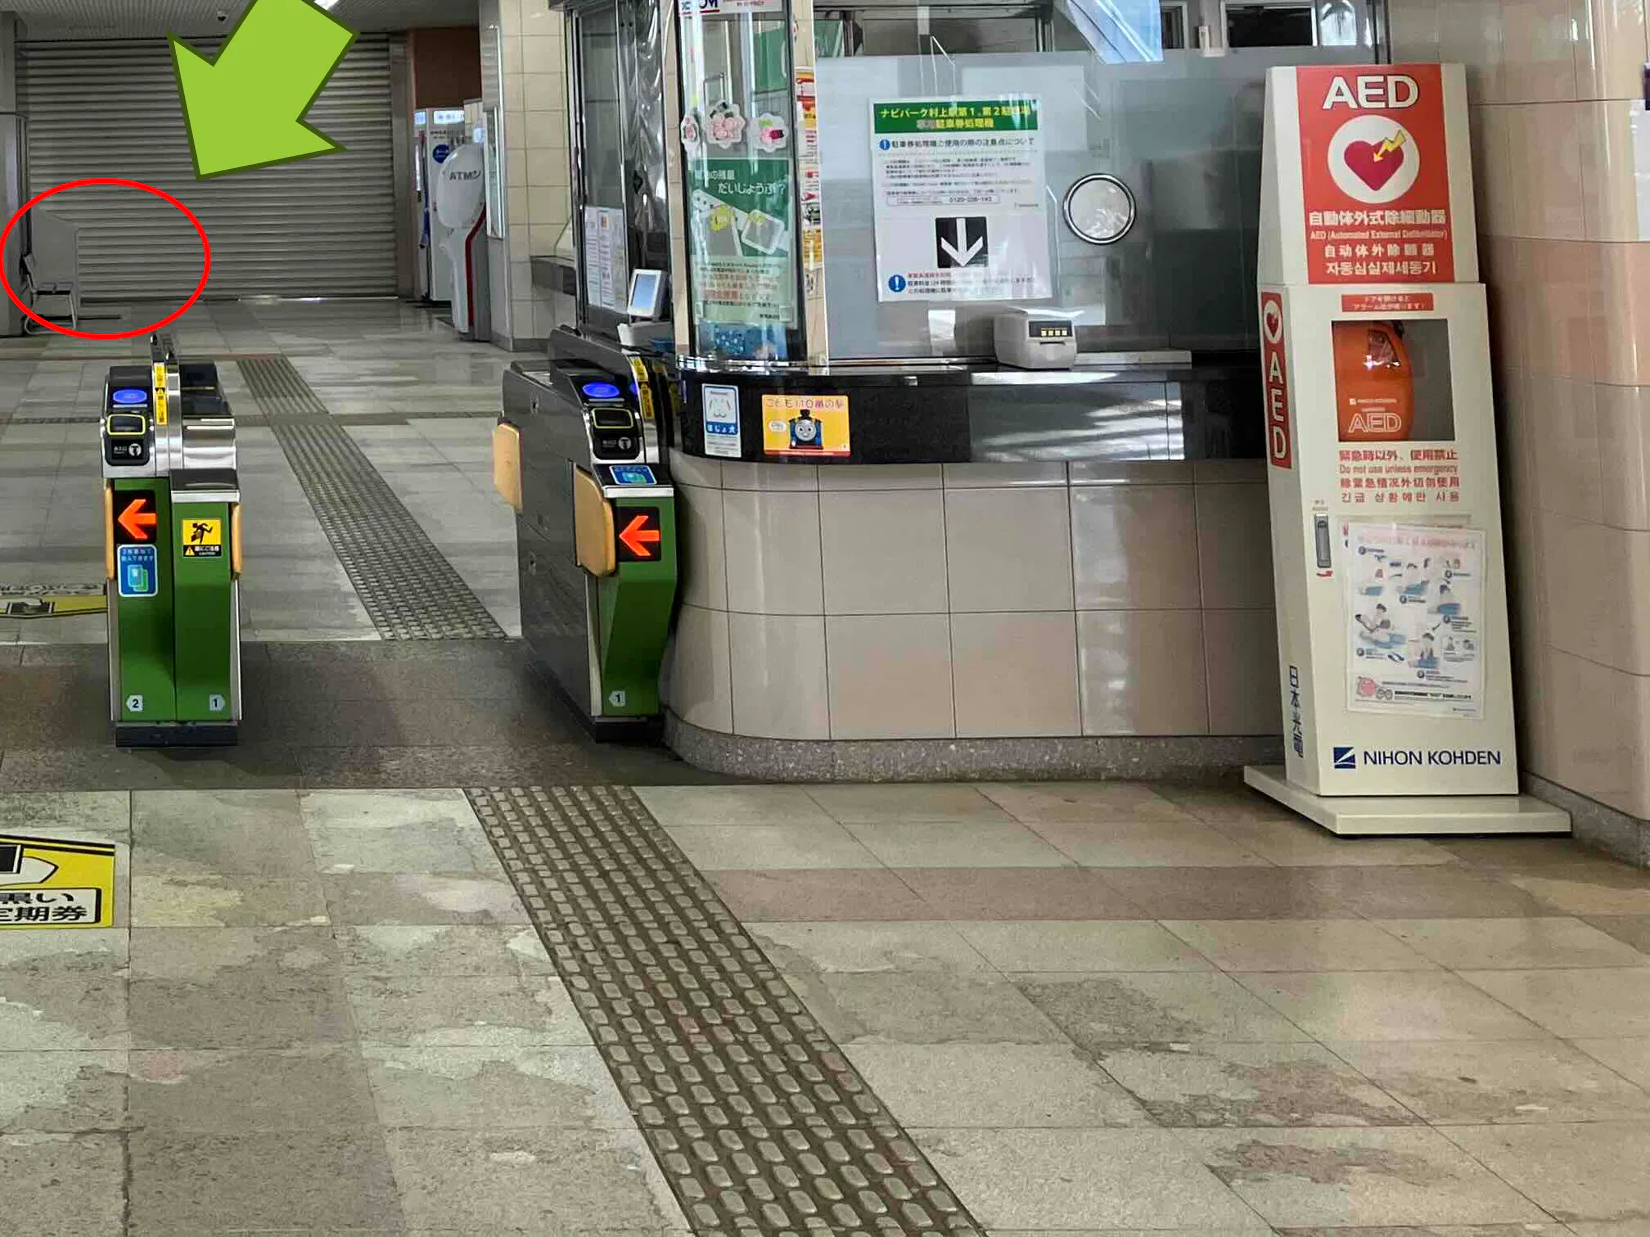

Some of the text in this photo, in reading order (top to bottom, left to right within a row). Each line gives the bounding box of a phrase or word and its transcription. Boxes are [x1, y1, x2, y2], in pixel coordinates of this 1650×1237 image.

[1321, 74, 1420, 110] AED
[449, 170, 473, 181] ATM
[1308, 209, 1447, 227] 自動体外式除細動器
[1310, 230, 1326, 240] AED
[1268, 351, 1288, 461] AED
[1347, 412, 1402, 434] AED
[1339, 464, 1351, 473] Do
[1352, 464, 1367, 474] not
[1368, 465, 1383, 473] use
[132, 698, 141, 709] 2
[213, 697, 219, 709] 1
[616, 692, 622, 703] 1
[1289, 665, 1304, 759] 日本光電
[1363, 749, 1502, 766] NIHON KOHDEN
